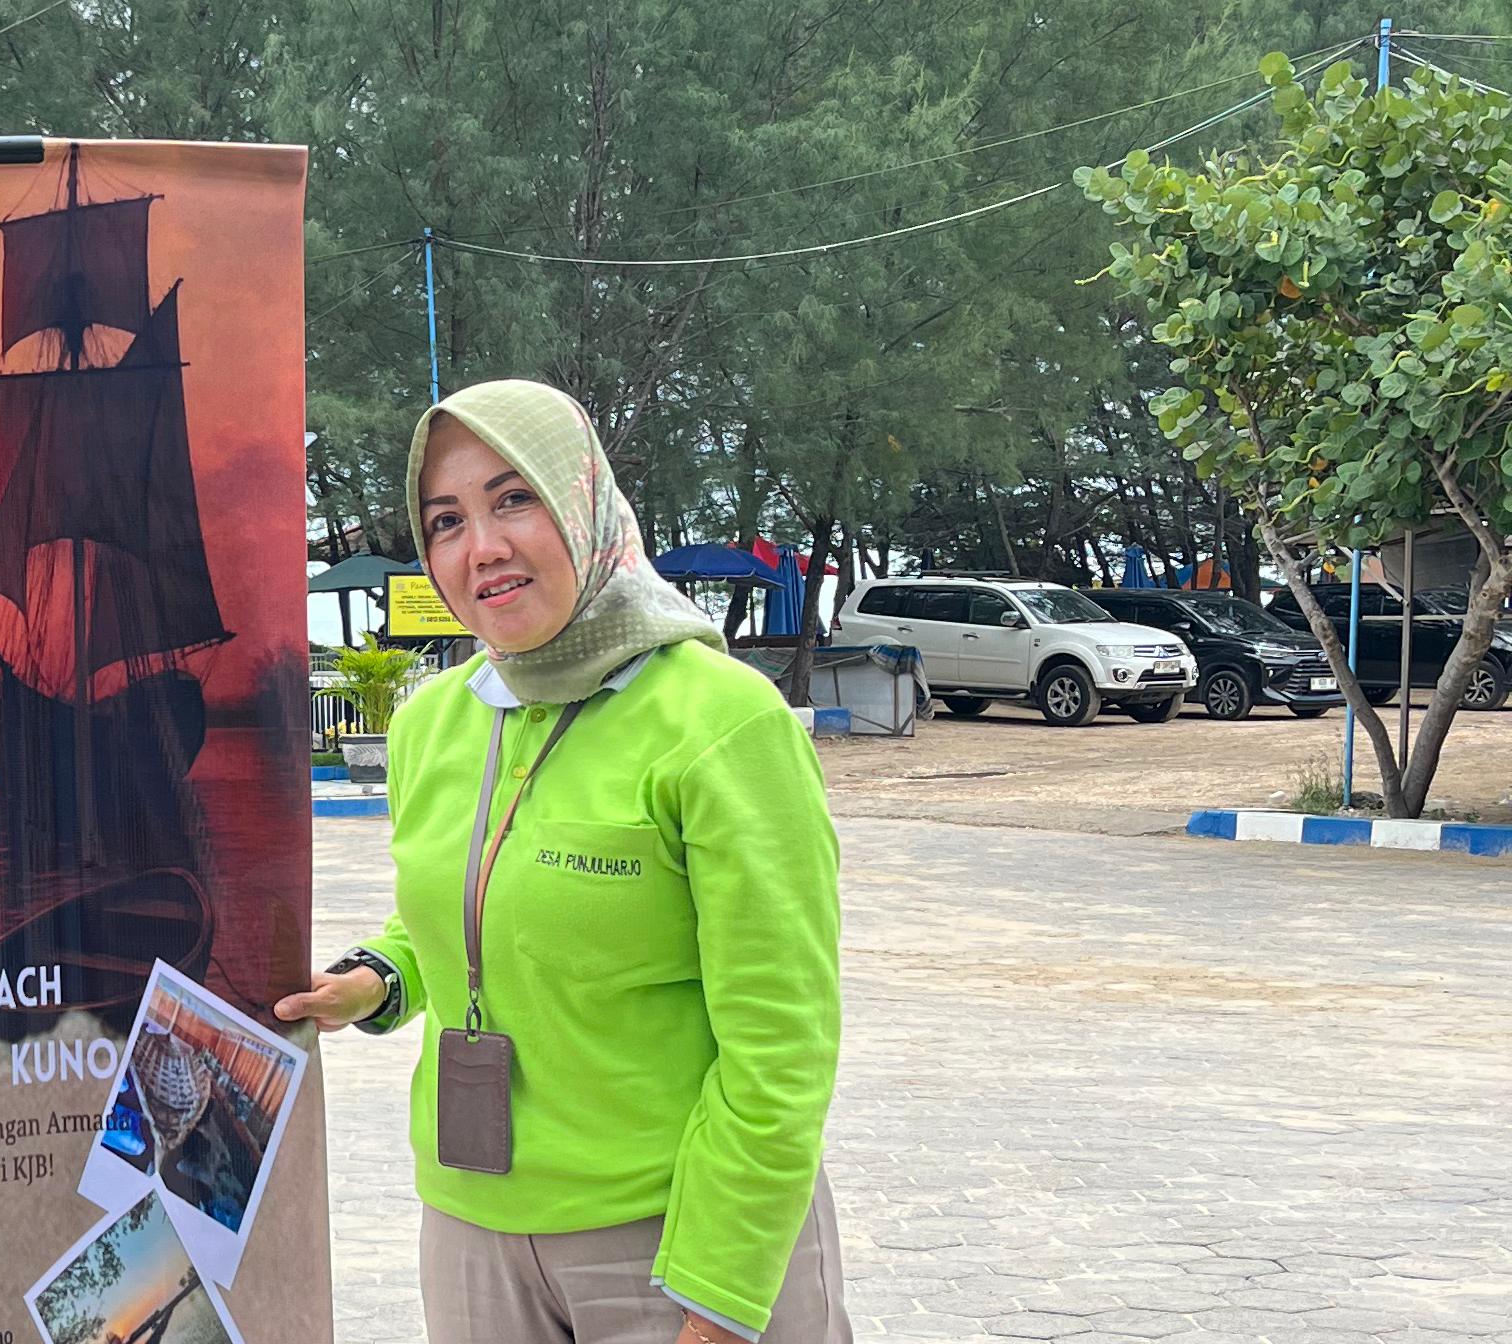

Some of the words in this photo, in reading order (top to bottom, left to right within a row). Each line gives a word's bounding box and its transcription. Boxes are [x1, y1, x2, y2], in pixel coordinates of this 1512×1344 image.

[535, 849, 560, 867] DESA
[565, 853, 641, 876] PUNJULHARJO
[11, 1038, 118, 1085] KUNO
[46, 1111, 131, 1135] Armada
[13, 1153, 55, 1186] KJB!
